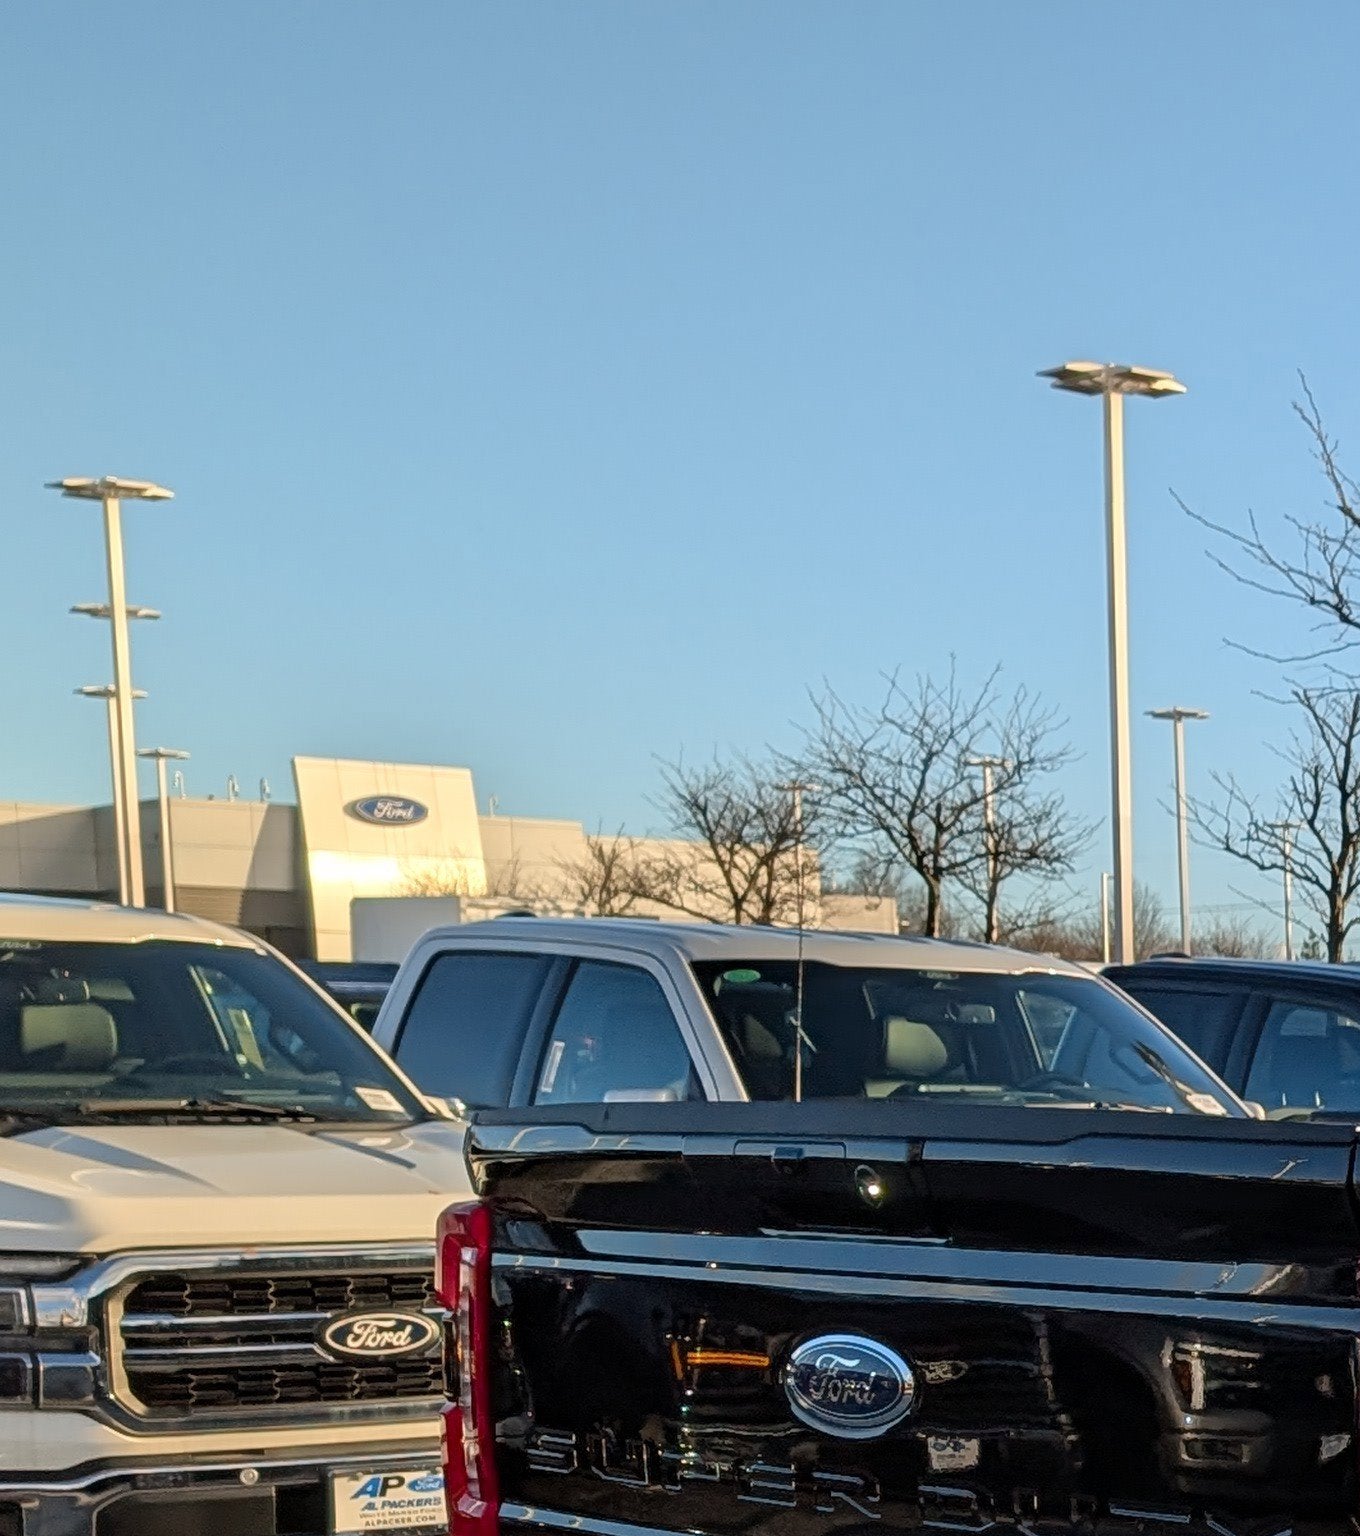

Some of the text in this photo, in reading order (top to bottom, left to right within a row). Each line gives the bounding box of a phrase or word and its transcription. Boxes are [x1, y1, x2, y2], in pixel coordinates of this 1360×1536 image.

[373, 800, 414, 819] Ford
[346, 1319, 412, 1348] Ford
[809, 1353, 876, 1404] Ford
[350, 1475, 406, 1499] AP
[526, 1430, 882, 1519] SUPER
